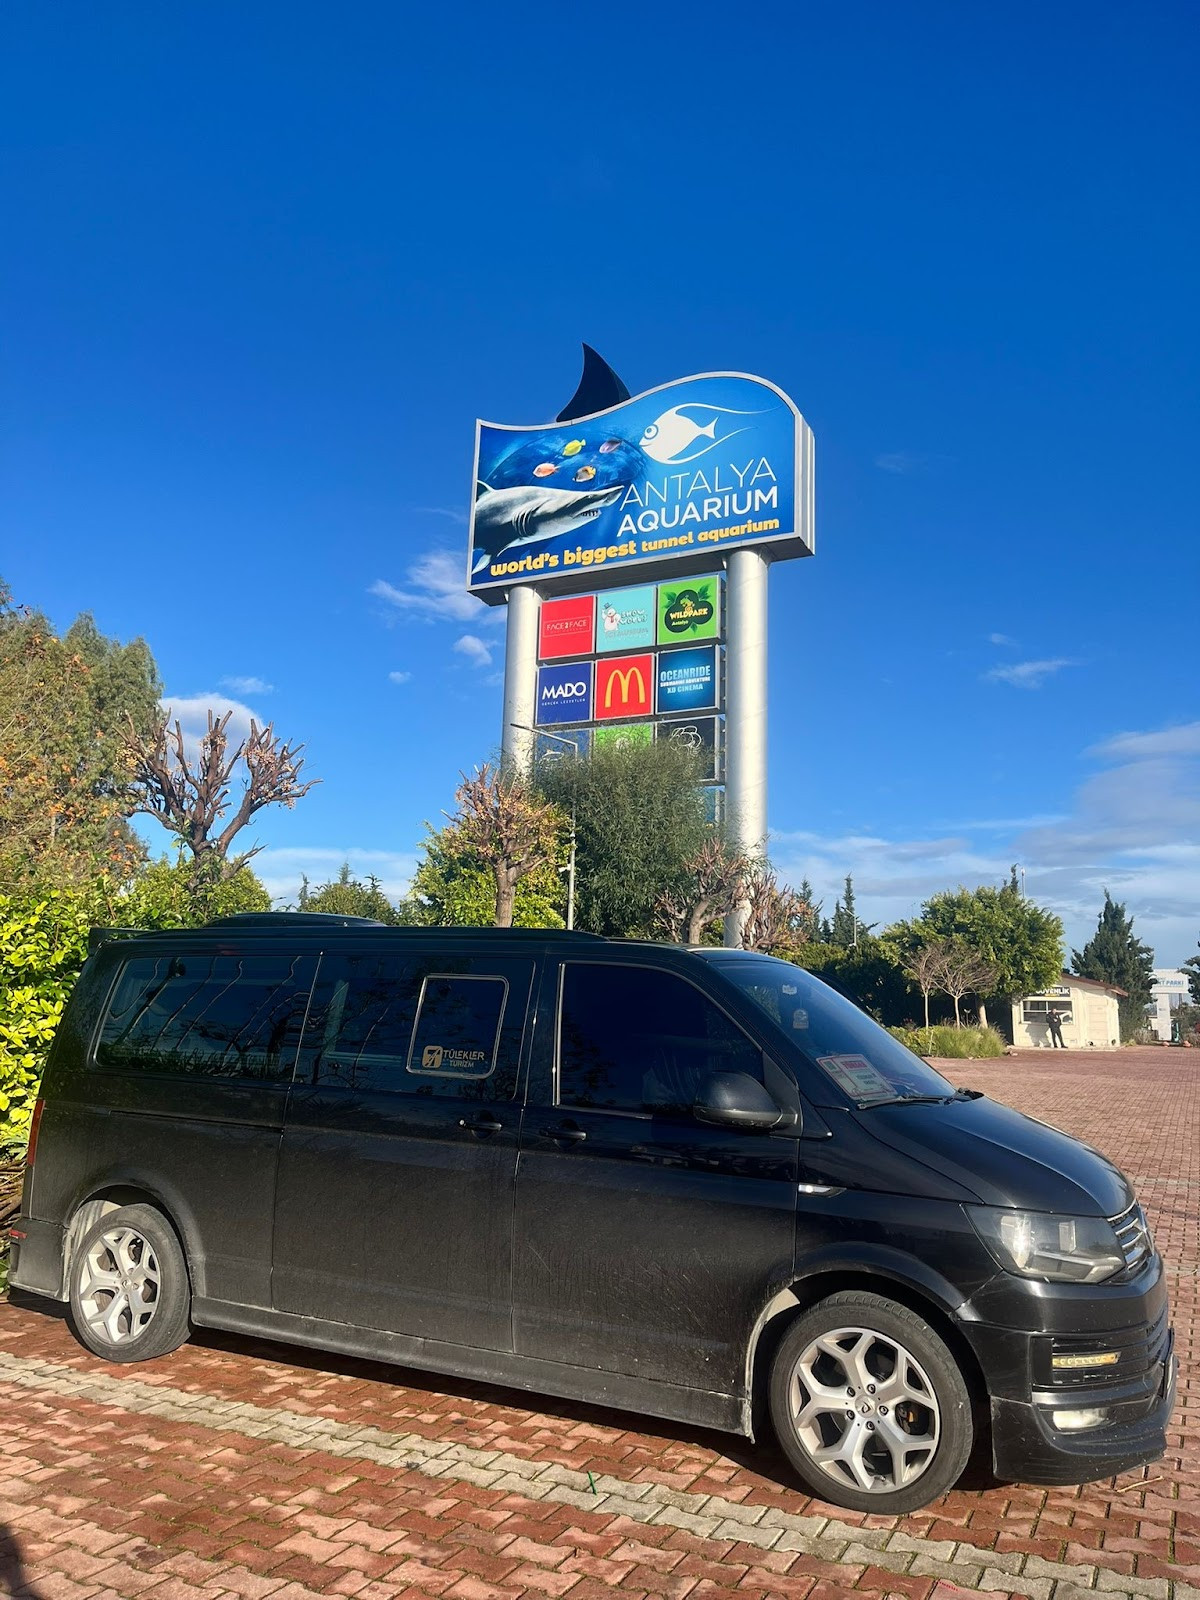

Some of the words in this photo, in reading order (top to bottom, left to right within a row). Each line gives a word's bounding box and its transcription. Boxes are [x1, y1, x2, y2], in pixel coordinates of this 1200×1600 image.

[619, 456, 777, 511] ANTALYA
[616, 485, 778, 537] AQUARIUM
[490, 552, 559, 576] world's
[563, 540, 637, 566] biggest
[641, 531, 694, 552] tunnel
[697, 518, 780, 542] aquarium
[669, 607, 708, 620] WILDPARK
[660, 665, 711, 682] OCEANRIDE
[541, 681, 587, 700] MADO
[677, 683, 704, 693] CINEMA
